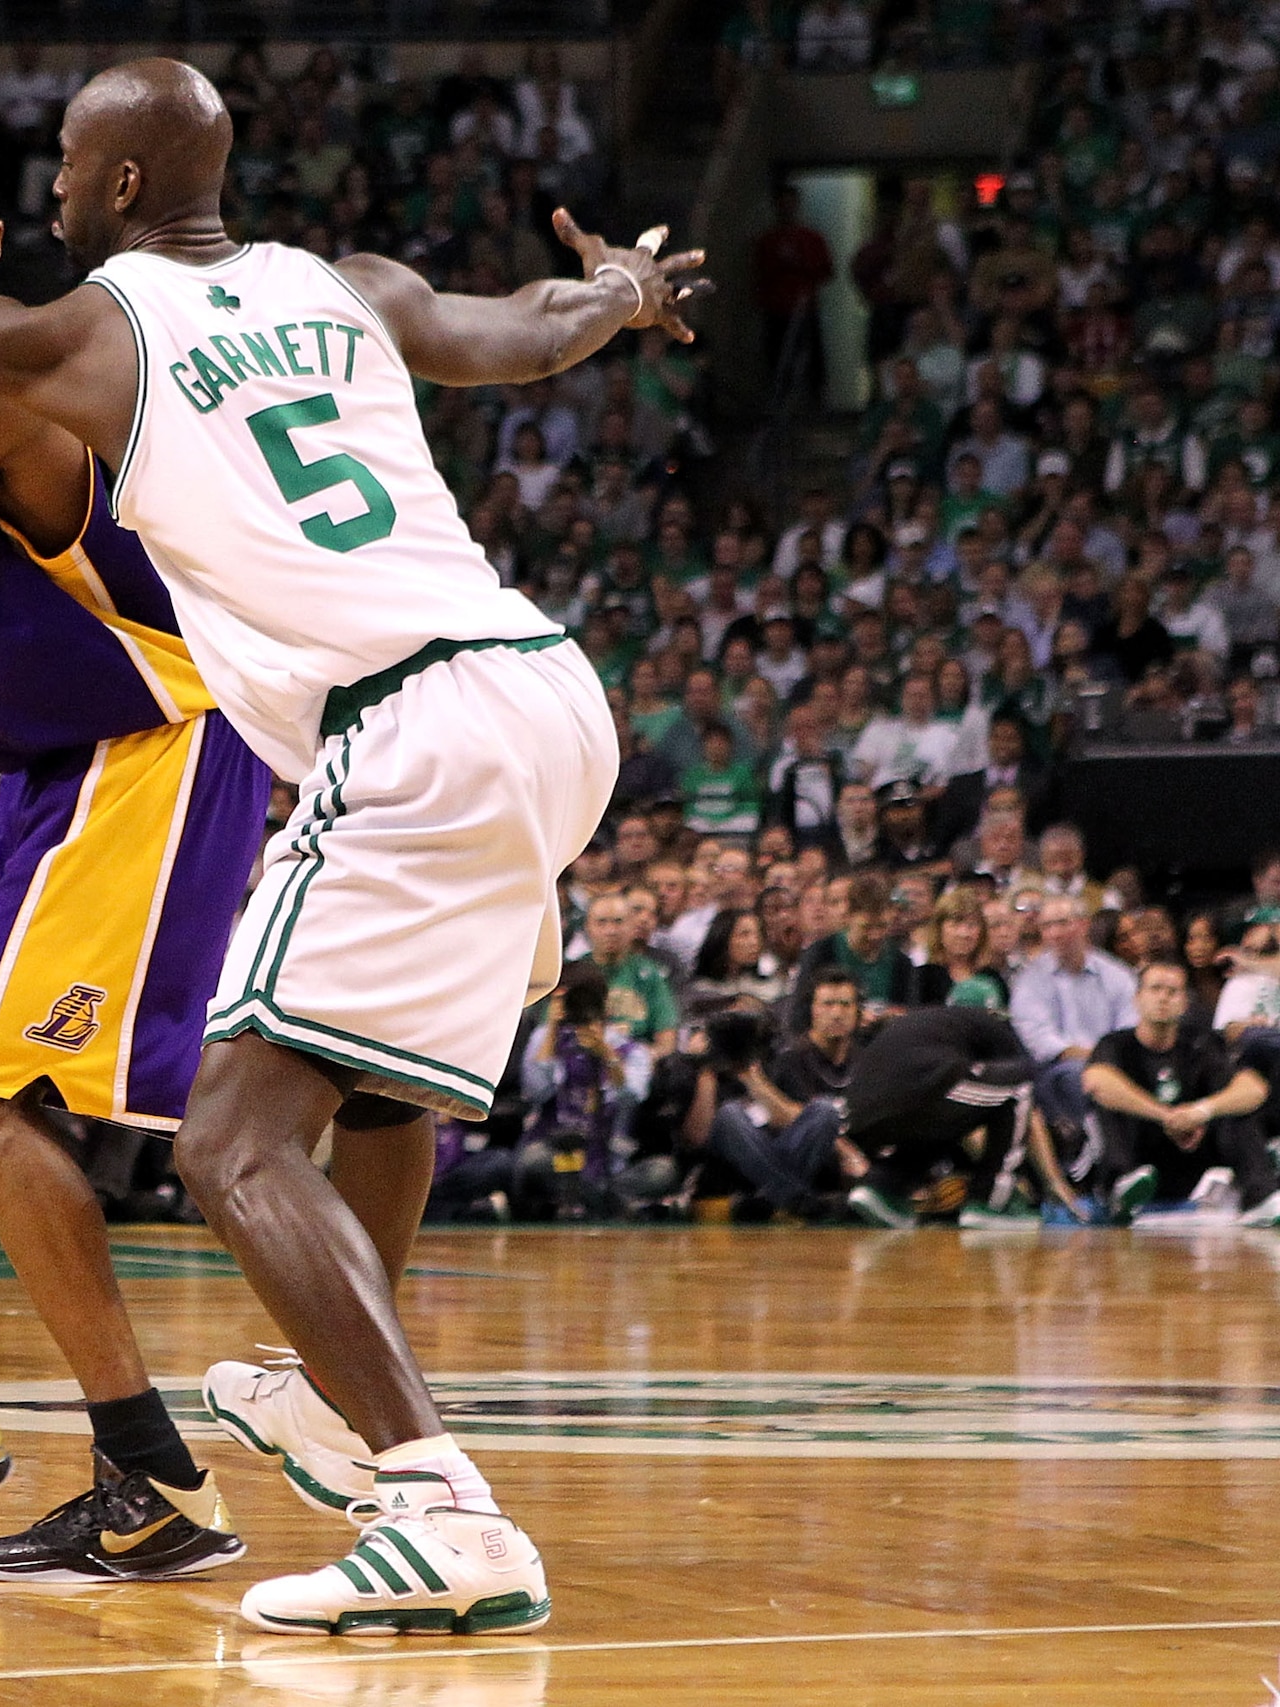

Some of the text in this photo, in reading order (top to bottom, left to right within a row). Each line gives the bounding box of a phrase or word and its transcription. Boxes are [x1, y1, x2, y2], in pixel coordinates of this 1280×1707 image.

[169, 321, 364, 414] GARNETT
[245, 393, 397, 553] 5
[481, 1528, 508, 1560] 5
